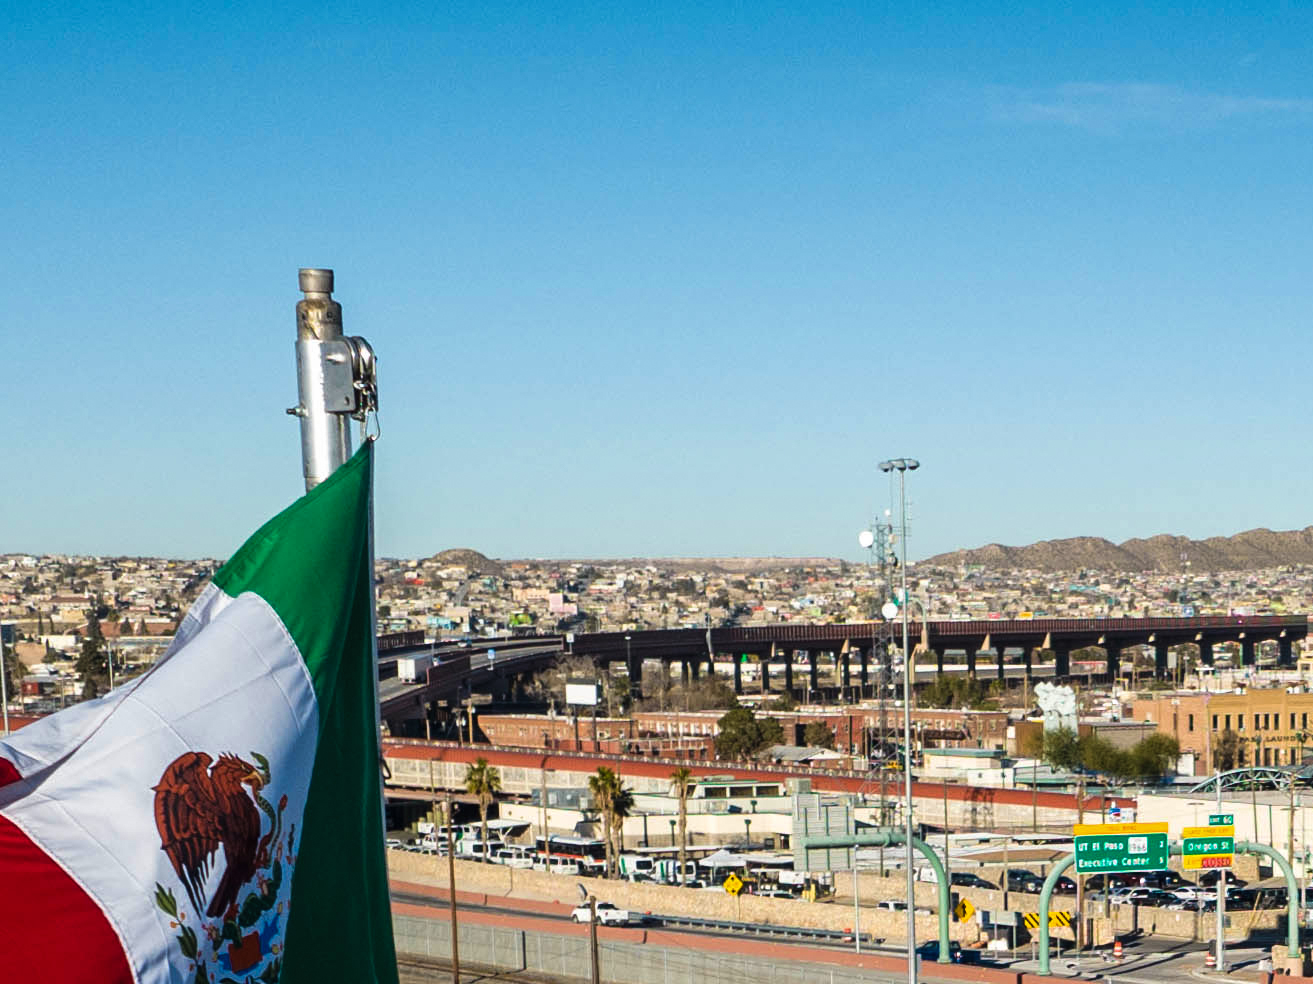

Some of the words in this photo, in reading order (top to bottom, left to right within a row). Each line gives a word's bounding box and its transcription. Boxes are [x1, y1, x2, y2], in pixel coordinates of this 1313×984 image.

[1078, 843, 1088, 851] UT
[1104, 841, 1124, 851] Paso
[1188, 842, 1217, 852] Oregon
[1221, 841, 1229, 850] St
[1078, 857, 1118, 868] Executive
[1122, 857, 1150, 866] Center
